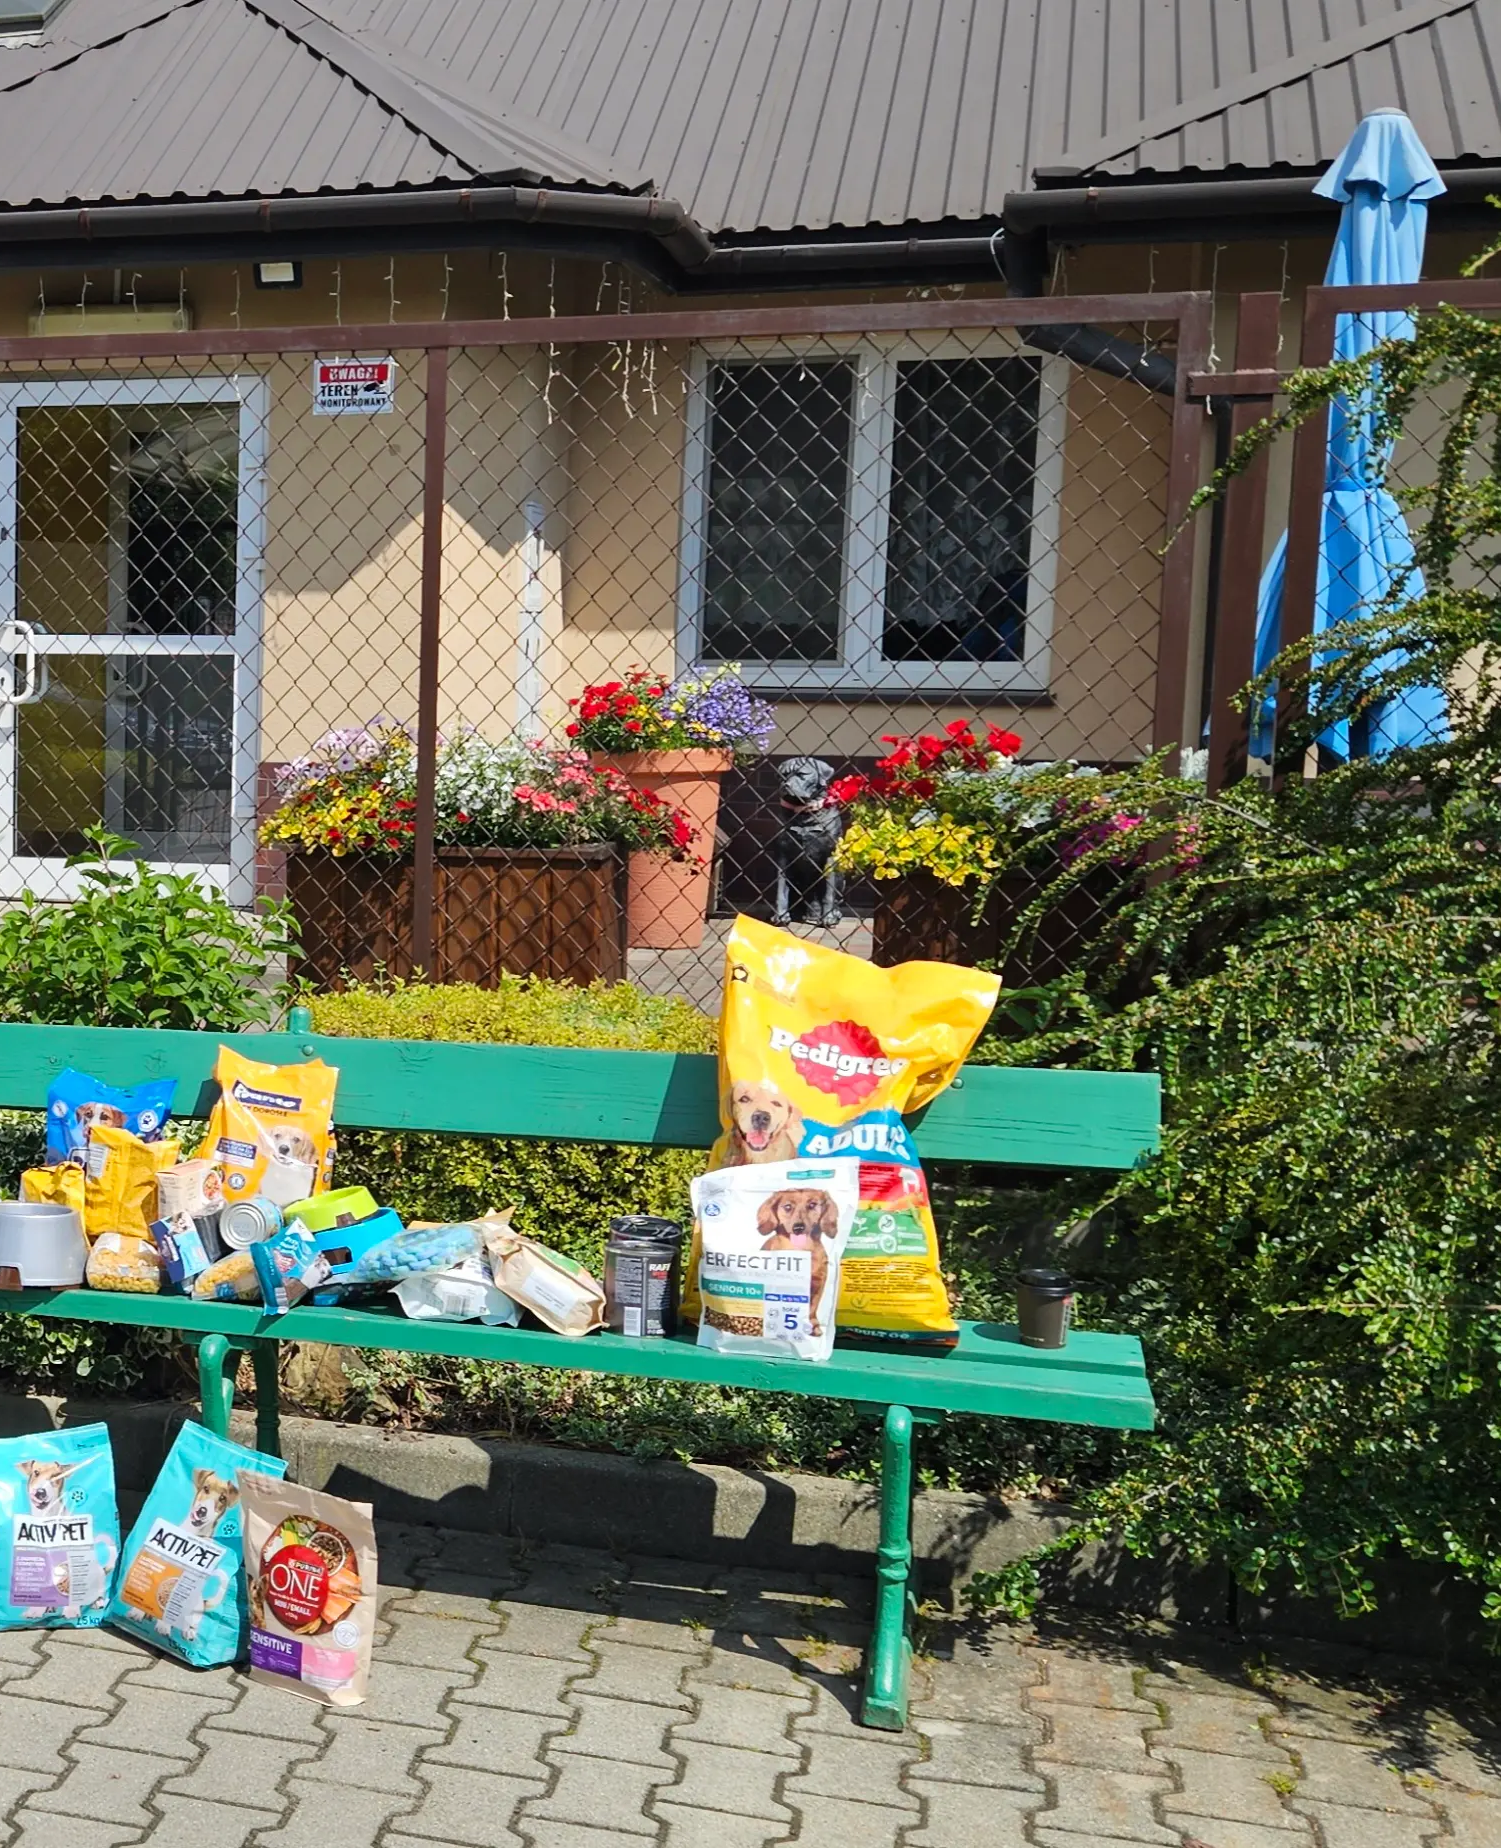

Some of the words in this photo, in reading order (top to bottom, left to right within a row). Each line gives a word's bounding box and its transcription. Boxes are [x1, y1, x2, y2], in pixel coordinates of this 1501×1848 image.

[329, 367, 378, 380] UWAGA!
[320, 384, 358, 397] TEREN
[769, 1026, 911, 1077] Pedigree
[705, 1251, 772, 1270] ERFECT
[776, 1256, 803, 1272] FIT
[708, 1282, 744, 1294] SENIOR
[745, 1287, 762, 1296] 10+
[784, 1313, 799, 1330] 5
[270, 1563, 322, 1602] ONE
[250, 1629, 293, 1655] SENSITIVE
